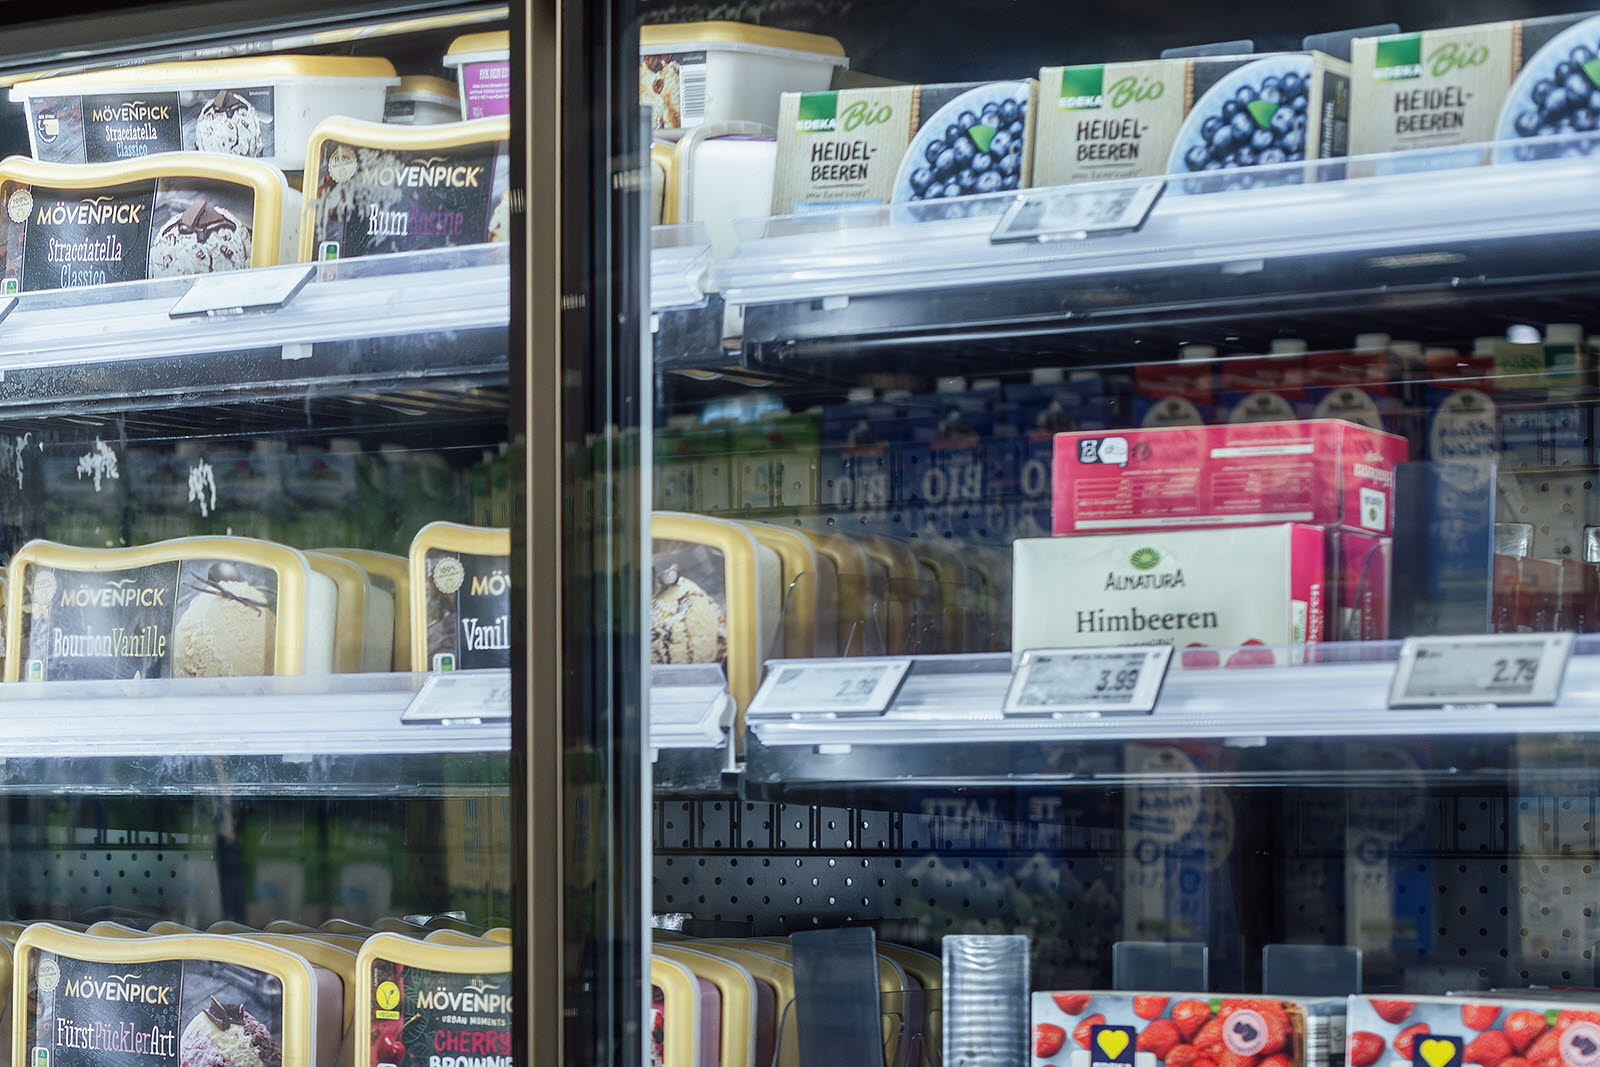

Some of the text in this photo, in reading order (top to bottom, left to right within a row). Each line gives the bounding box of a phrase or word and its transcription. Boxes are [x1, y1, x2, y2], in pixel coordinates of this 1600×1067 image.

[1428, 42, 1490, 77] Bio
[1107, 76, 1164, 109] Bio
[1394, 86, 1474, 113] HEIDEL-
[92, 102, 169, 122] MÖVENPICK
[795, 101, 892, 132] EDEKA Bio
[1395, 112, 1465, 134] BEEREN
[105, 123, 157, 141] Stracciatella
[1076, 117, 1149, 141] HEIDEL-
[811, 140, 877, 164] HEIDEL-
[1076, 142, 1140, 162] BEEREN
[811, 162, 868, 182] BEEREN
[37, 202, 142, 225] MÖVENPICK
[48, 236, 122, 262] Stracciatella
[61, 583, 165, 608] MÖVENPICK
[1076, 606, 1219, 634] Himbeeren
[65, 976, 169, 1005] MÖVENPICK
[441, 1016, 506, 1026] URBAN MOMENTS
[434, 1029, 511, 1056] CHERRY
